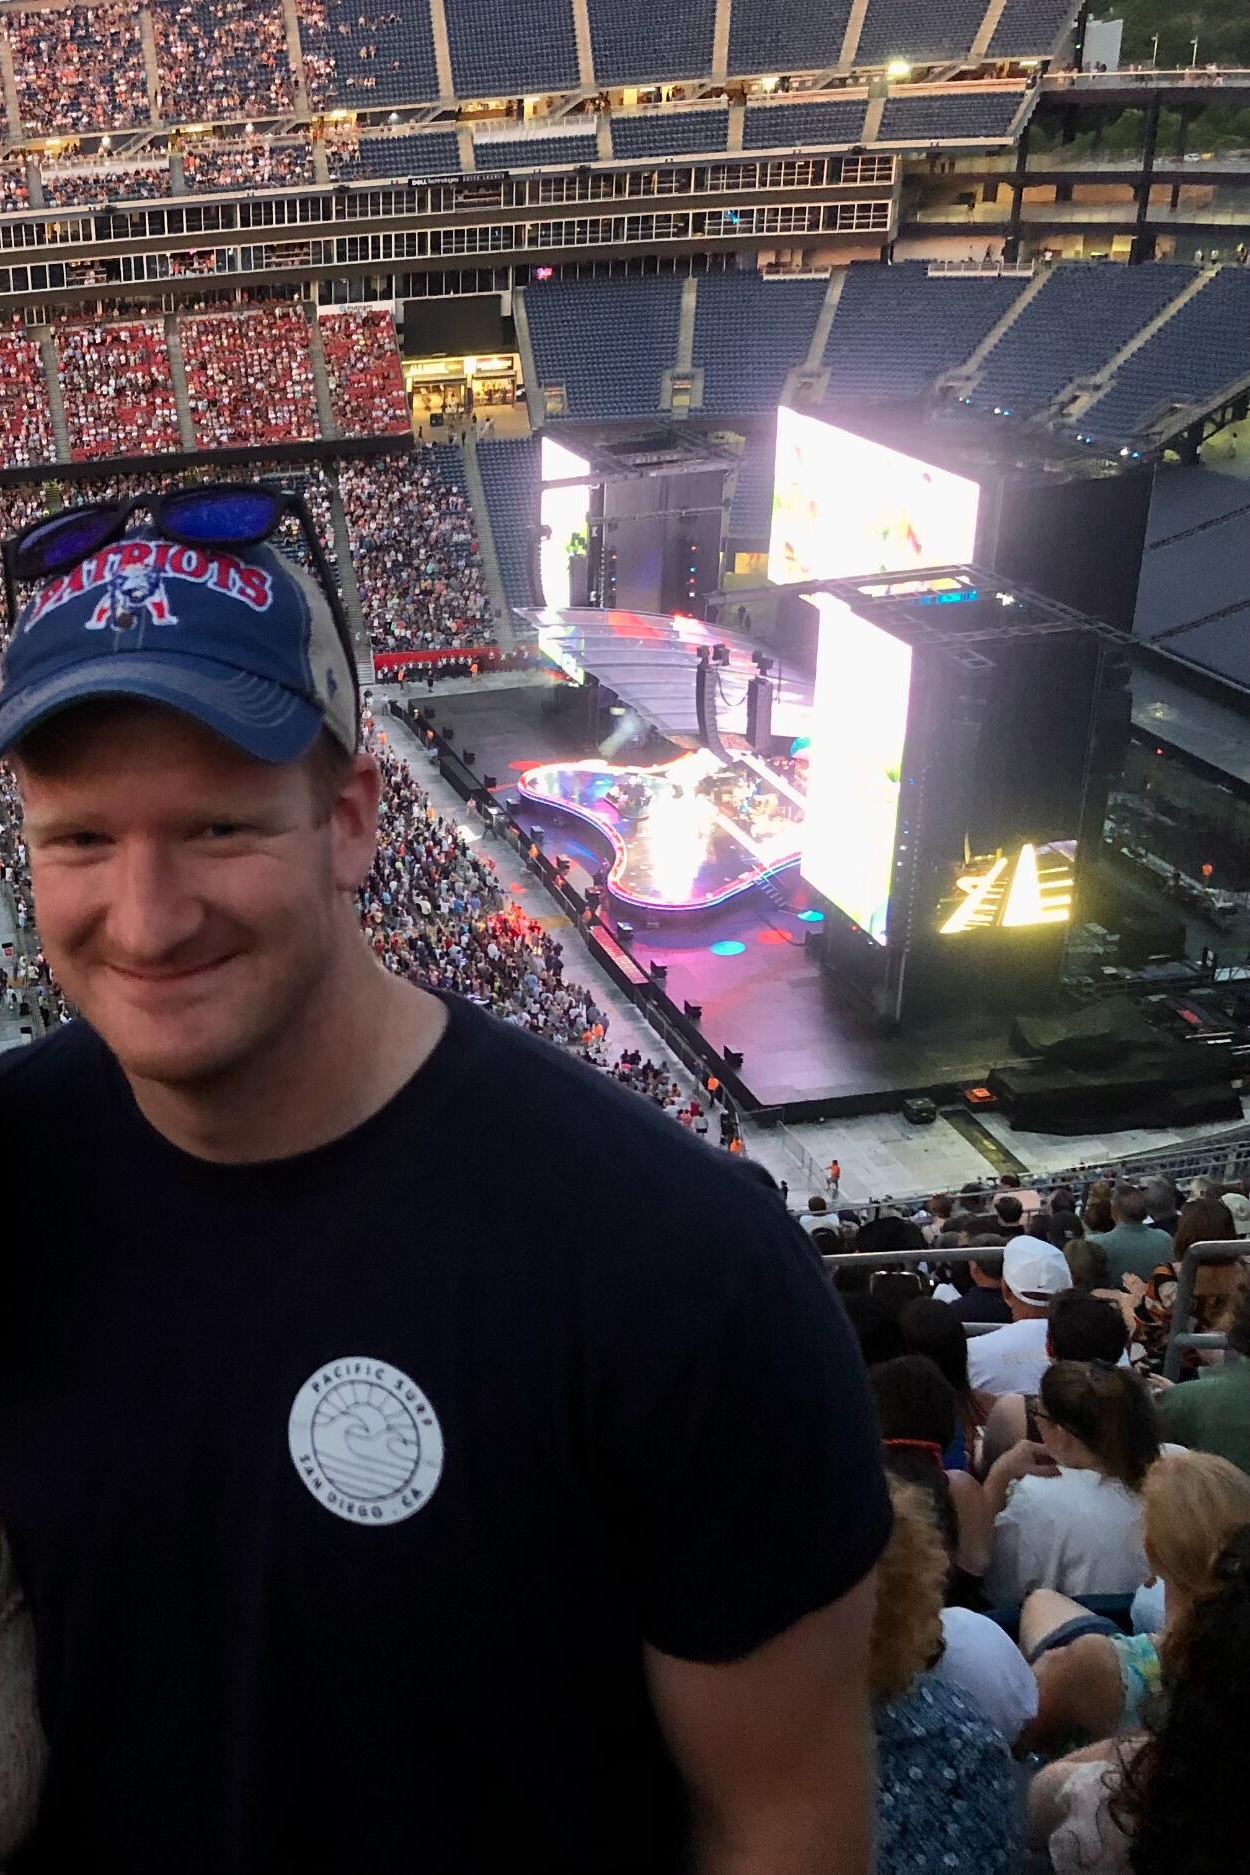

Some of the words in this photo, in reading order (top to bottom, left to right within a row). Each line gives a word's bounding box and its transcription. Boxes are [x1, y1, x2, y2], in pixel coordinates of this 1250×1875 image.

[411, 178, 428, 186] DELL
[23, 538, 274, 634] PATRIOTS
[311, 1361, 386, 1394] PACIFIC
[393, 1378, 434, 1427] SURF
[299, 1454, 323, 1491] SAN
[401, 1487, 423, 1509] CA
